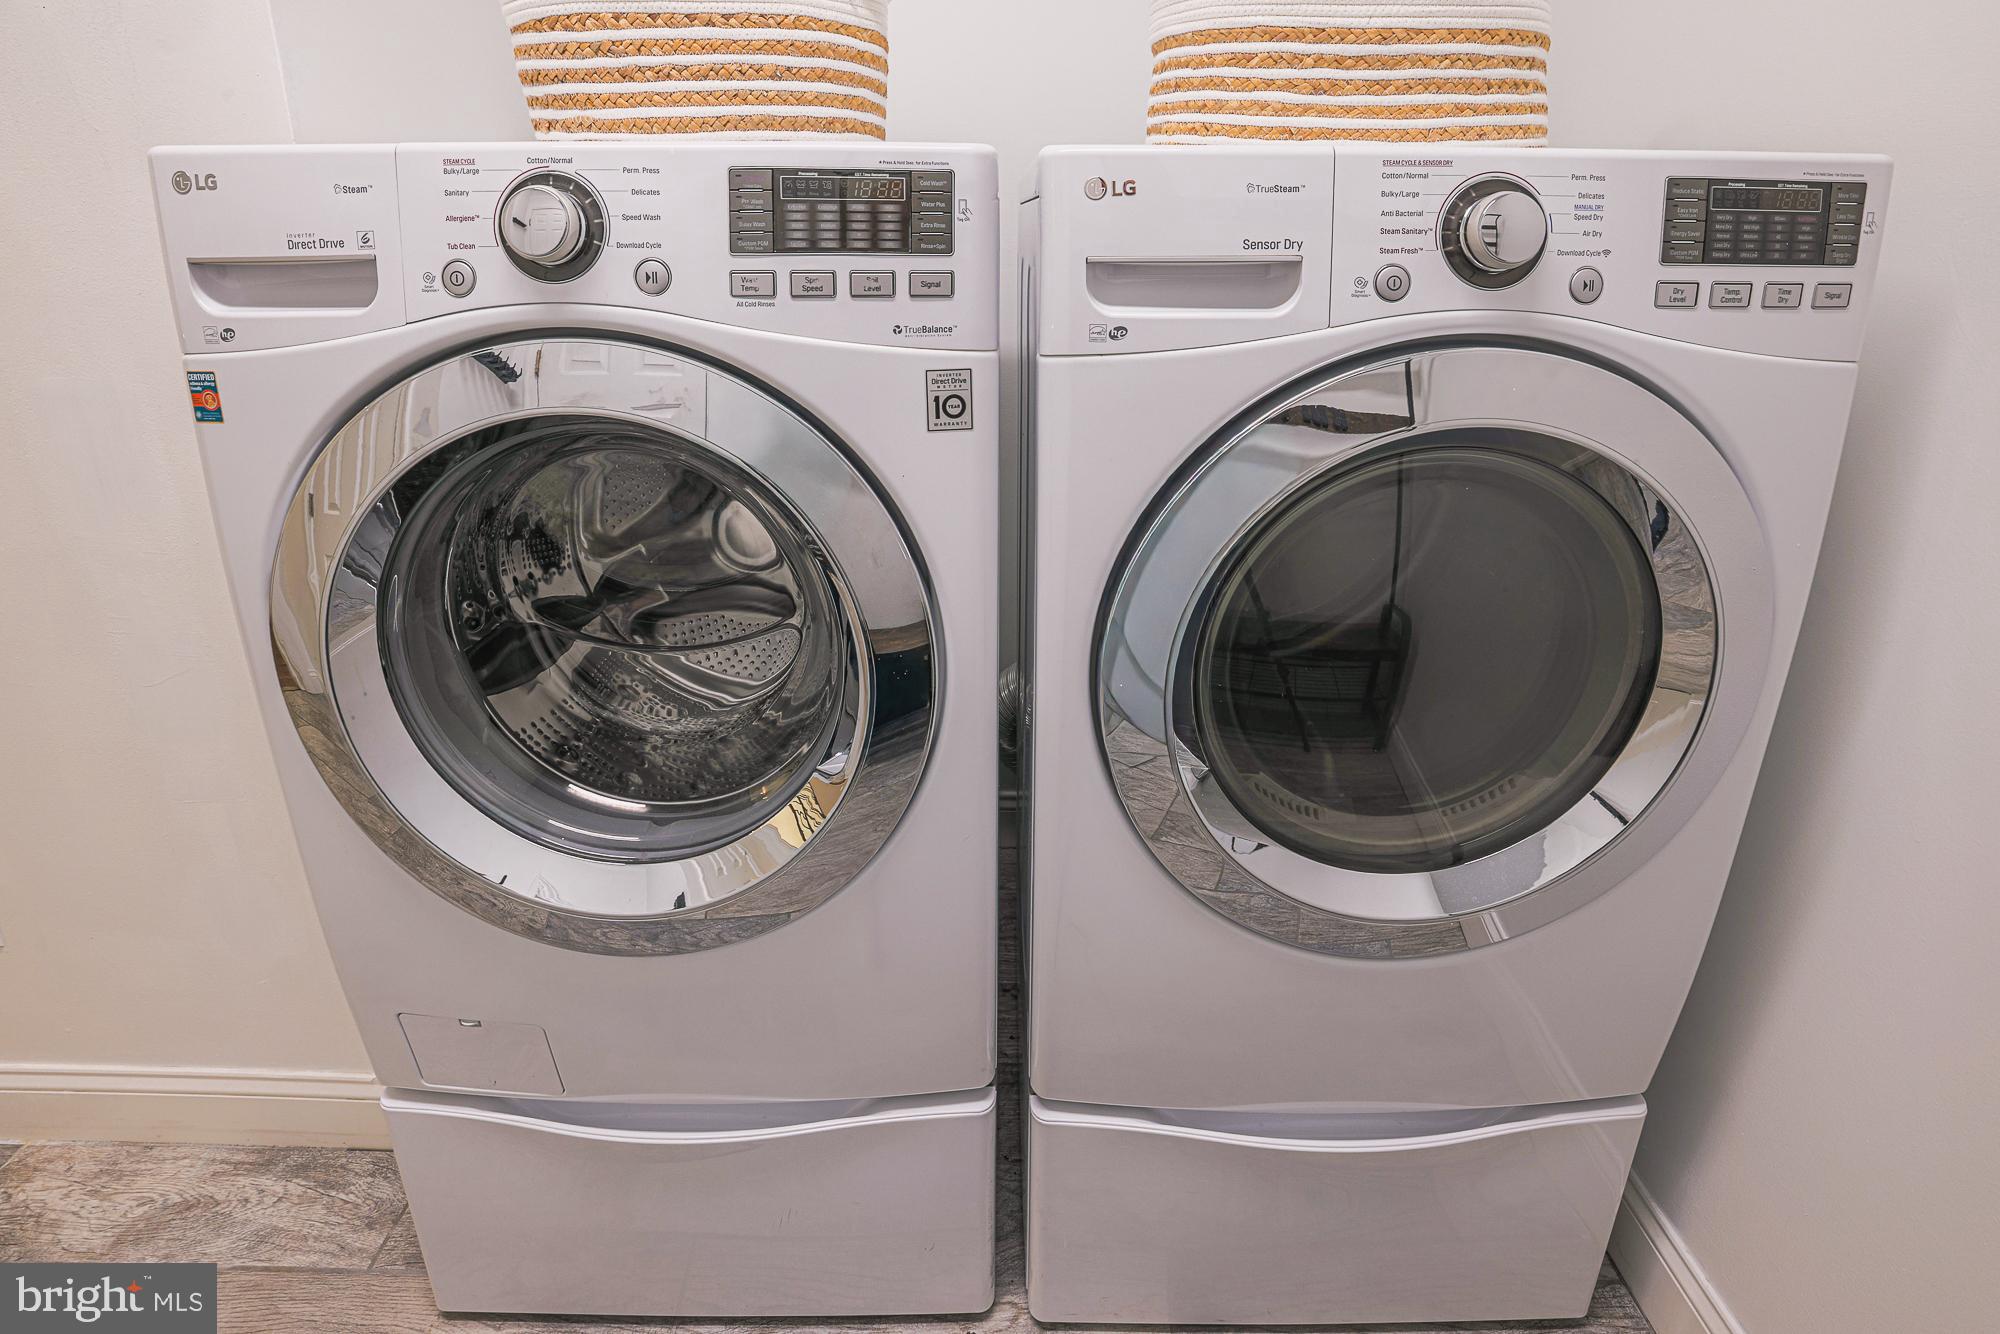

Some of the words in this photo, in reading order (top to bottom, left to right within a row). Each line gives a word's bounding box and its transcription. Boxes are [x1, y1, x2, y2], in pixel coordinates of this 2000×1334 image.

[195, 173, 218, 191] LG
[1112, 180, 1136, 197] LG
[444, 189, 469, 197] Sanitary
[287, 239, 317, 250] Direct
[319, 238, 345, 249] Drive
[1243, 238, 1281, 251] Sensor
[1284, 239, 1303, 252] Dry
[921, 280, 941, 289] Signal
[741, 285, 759, 293] Temp
[801, 285, 823, 293] Speed
[1673, 287, 1685, 295] Dry
[1777, 296, 1789, 304] Dry
[1824, 292, 1842, 300] Signal
[933, 394, 966, 419] 10
